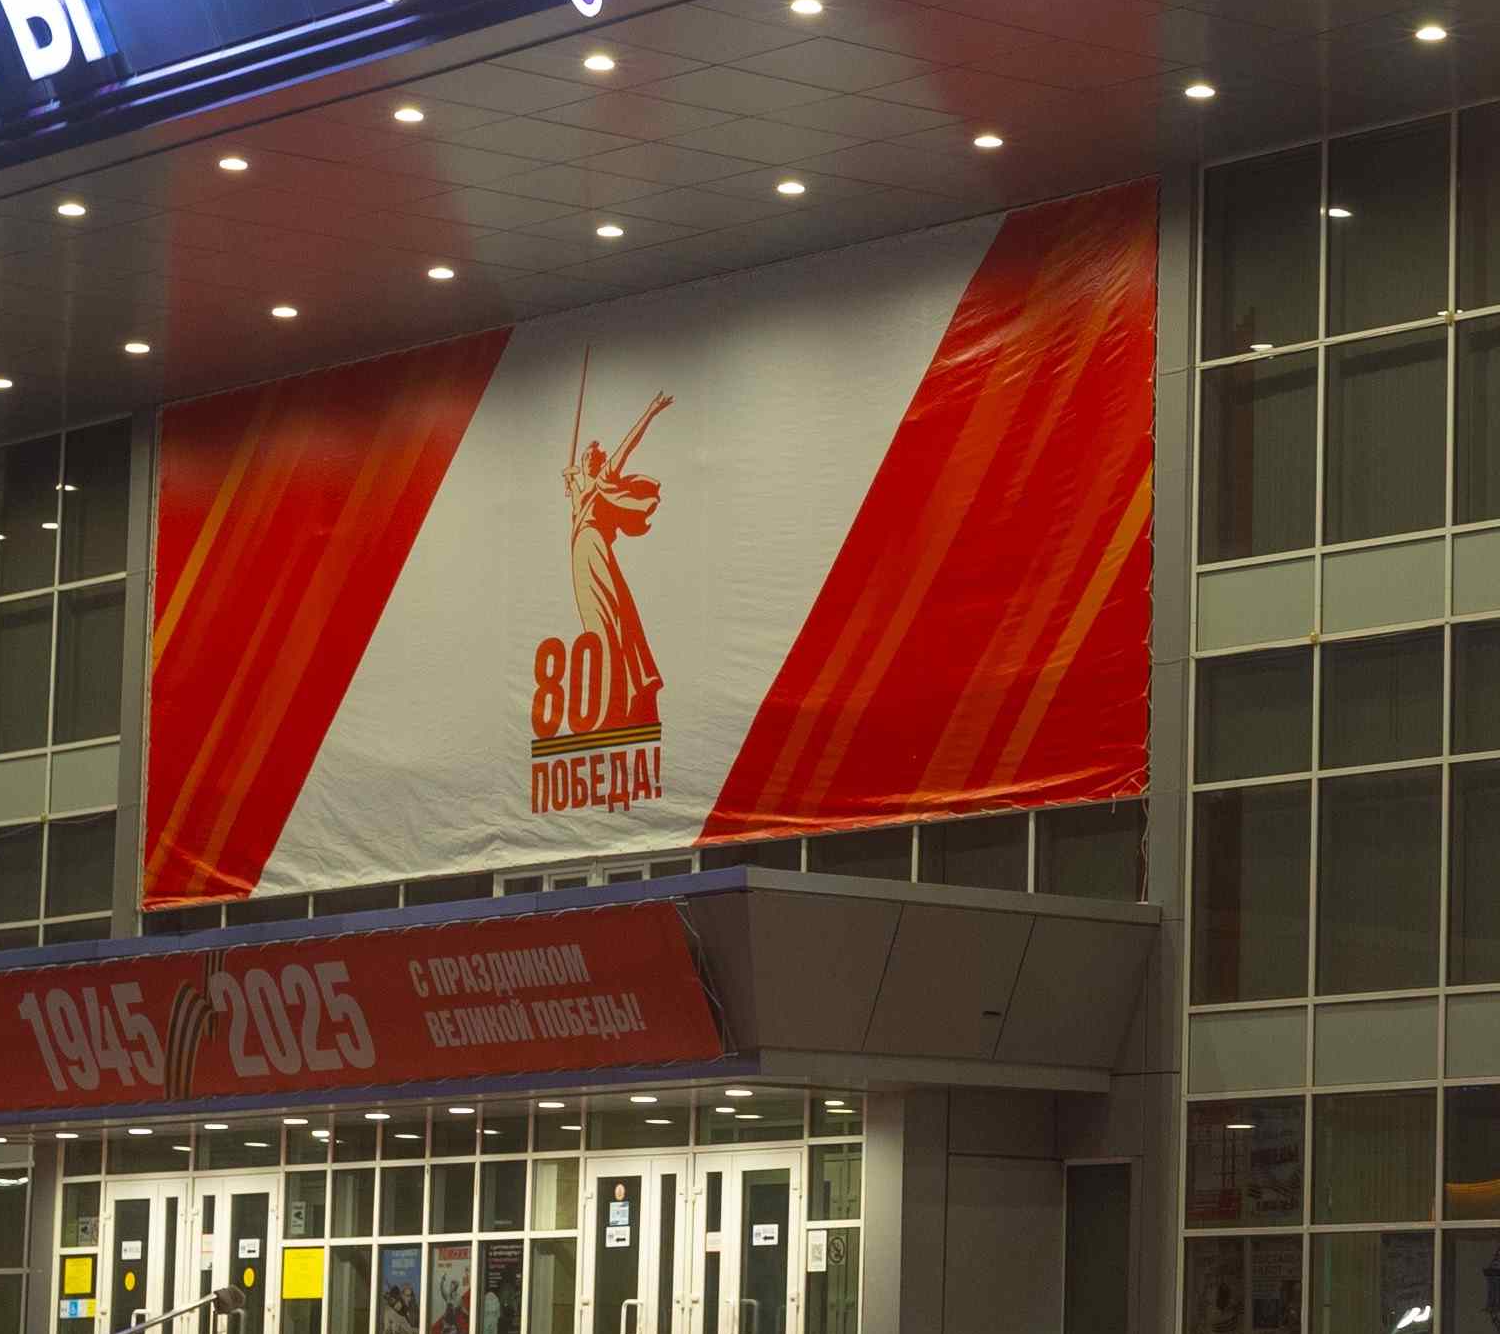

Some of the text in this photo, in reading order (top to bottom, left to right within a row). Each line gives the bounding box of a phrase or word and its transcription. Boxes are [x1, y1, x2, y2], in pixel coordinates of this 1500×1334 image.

[531, 631, 604, 739] 80
[530, 746, 663, 814] ПОБЕДА!
[408, 943, 591, 999] С ПРАЗДНИКОМ
[17, 960, 376, 1092] 1945 2025
[424, 991, 647, 1048] ВЕЛИКОЙ ПОБЕДЫ!
